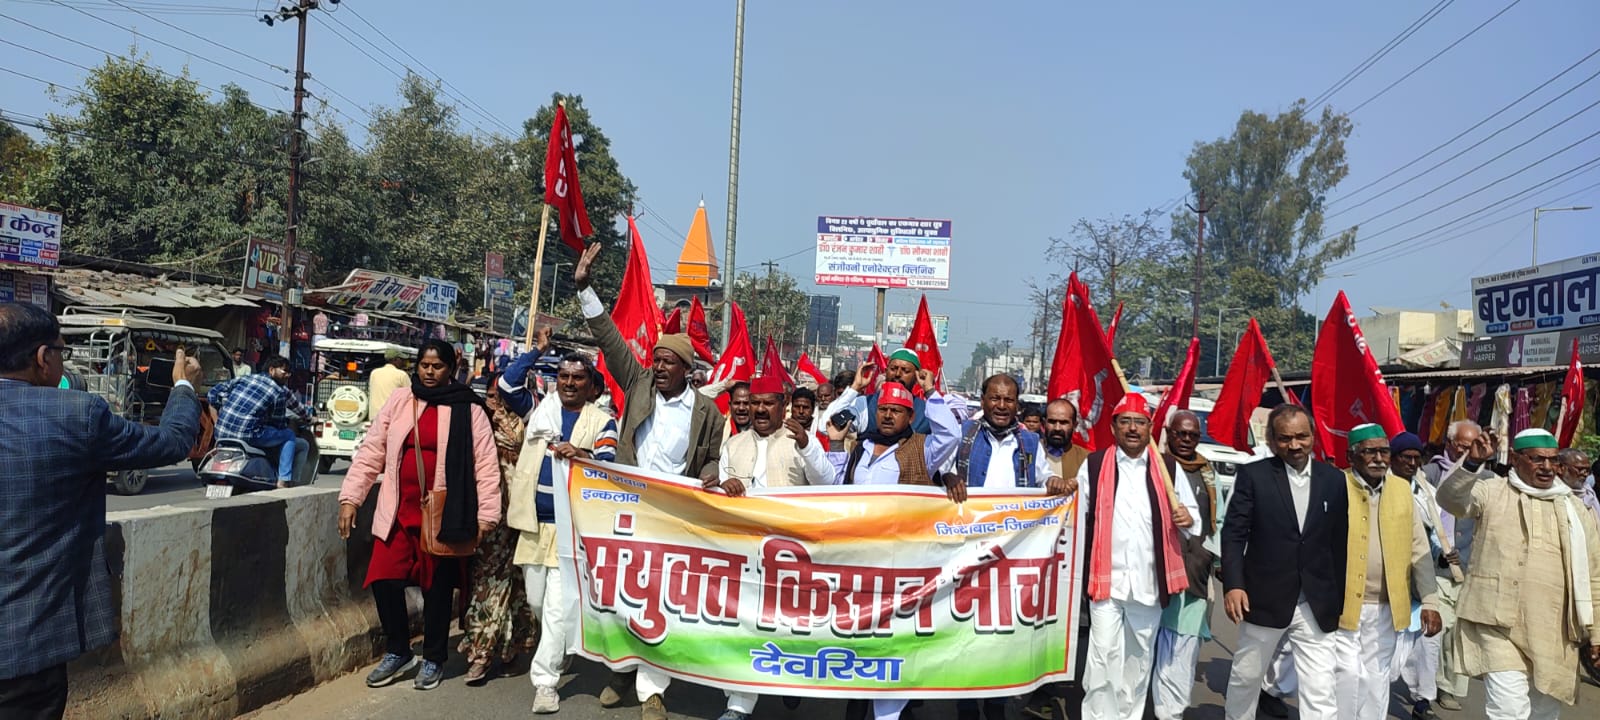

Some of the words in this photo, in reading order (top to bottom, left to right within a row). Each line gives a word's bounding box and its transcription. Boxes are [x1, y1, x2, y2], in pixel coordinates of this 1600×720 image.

[260, 250, 279, 272] VIP
[828, 262, 861, 273] संजीवनी
[1473, 353, 1496, 362] HARPER
[583, 468, 608, 479] जय
[994, 503, 1019, 511] जय
[578, 513, 748, 644] संयुक्त
[759, 535, 942, 638] किसान
[949, 529, 1066, 634] मोर्चा
[751, 642, 905, 682] देवरिया
